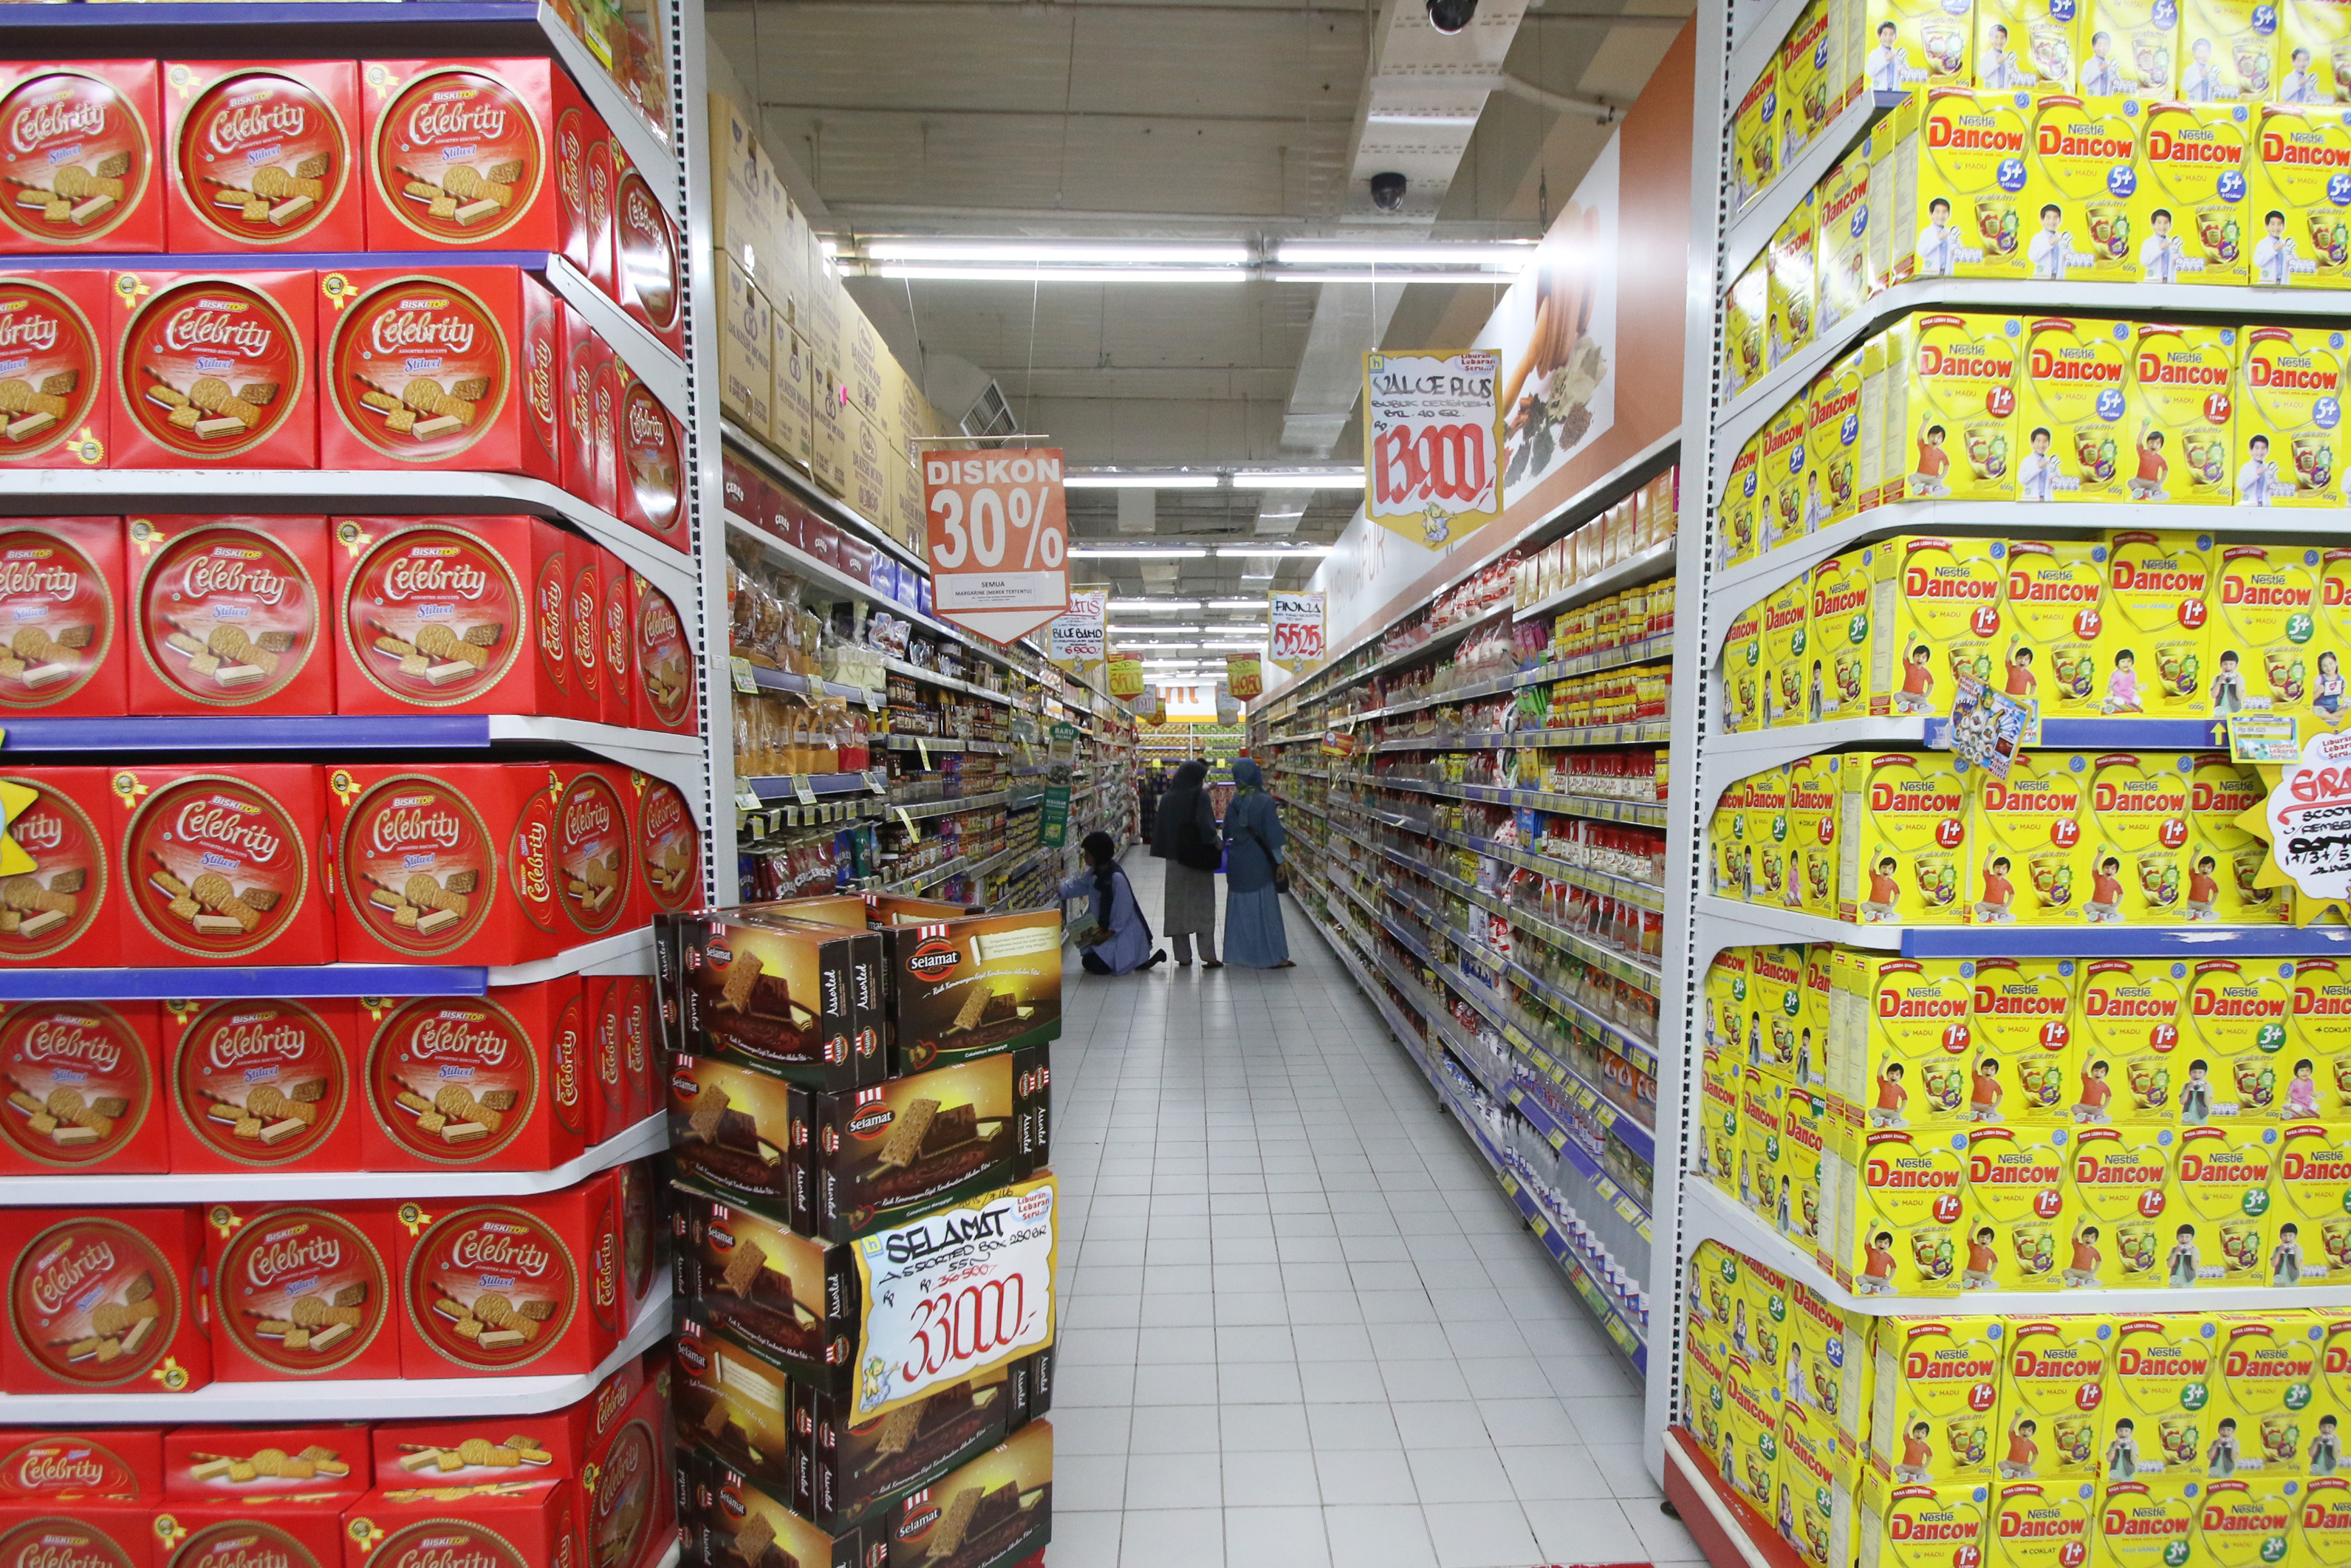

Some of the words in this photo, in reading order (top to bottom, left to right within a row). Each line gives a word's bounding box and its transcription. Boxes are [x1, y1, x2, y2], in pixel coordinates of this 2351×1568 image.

[11, 100, 106, 153] Celebrity
[408, 102, 506, 149] Celebrity
[1929, 117, 2023, 152] Dancow
[2149, 131, 2243, 164] Dancow
[1965, 162, 1987, 171] MADU
[2000, 160, 2023, 184] 5+
[2111, 165, 2132, 191] 5+
[165, 307, 272, 357] Celebrity
[372, 309, 475, 355] Celebrity
[2032, 348, 2122, 380] Dancow
[2251, 357, 2338, 391] Dancow
[1372, 373, 1445, 396] VALUE
[1450, 377, 1492, 398] PLUS
[1991, 386, 2012, 410] 1+
[629, 405, 665, 445] Celebrity
[927, 459, 1061, 485] DISKON
[726, 482, 744, 501] CERES
[776, 515, 790, 532] CERES
[931, 487, 1064, 569] 30%
[0, 561, 78, 602] elebrity
[383, 558, 487, 600] Celebrity
[2008, 571, 2099, 603] Dancow
[2112, 561, 2205, 592] Dancow
[1276, 600, 1321, 613] FINNA
[1814, 588, 1867, 619] Dancow
[2181, 598, 2204, 621] 1+
[544, 579, 562, 662] Celebrity
[578, 591, 594, 668] Celebrity
[643, 609, 676, 646] Celebrity
[1053, 628, 1074, 638] BLUE
[1075, 629, 1102, 638] BAND
[2289, 613, 2311, 637] 3+
[1055, 727, 1074, 735] BARU
[1791, 789, 1834, 810] Dancow
[1872, 783, 1962, 812] Dancow
[2095, 783, 2185, 811] Dancow
[372, 809, 461, 853] Celebrity
[564, 801, 611, 846] Celebrity
[527, 821, 547, 903] Celebrity
[706, 946, 732, 961] Selamat
[911, 951, 958, 969] Selamat
[855, 963, 869, 1011] Assorted
[2087, 988, 2177, 1018] Dancow
[2194, 987, 2285, 1018] Dancow
[24, 1022, 121, 1072] Celebrity
[209, 1021, 305, 1069] Celebrity
[2260, 1025, 2284, 1046] 3+
[672, 1077, 698, 1092] Selamat
[850, 1112, 892, 1132] Selamat
[1867, 1159, 1961, 1190] Dancow
[2078, 1155, 2164, 1185] Dancow
[1017, 1192, 1046, 1205] Liburan
[1018, 1199, 1050, 1213] Lebaran
[708, 1227, 734, 1246] Selamat
[886, 1208, 1010, 1264] SELAMAT
[451, 1230, 550, 1276] Celebrity
[877, 1245, 974, 1287] ASSORTED
[979, 1239, 1007, 1252] BOX
[32, 1239, 115, 1315] Celebrity
[827, 1273, 841, 1320] Assorted
[1907, 1352, 1994, 1380] Dancow
[2120, 1349, 2207, 1377] Dancow
[2224, 1351, 2313, 1379] Dancow
[21, 1457, 104, 1489] Celebrity
[719, 1490, 745, 1514] Selamat
[899, 1510, 939, 1538] Selamat
[1892, 1513, 1979, 1542] Dancow
[2105, 1510, 2191, 1538] Dancow
[2030, 1547, 2056, 1555] COKLAT
